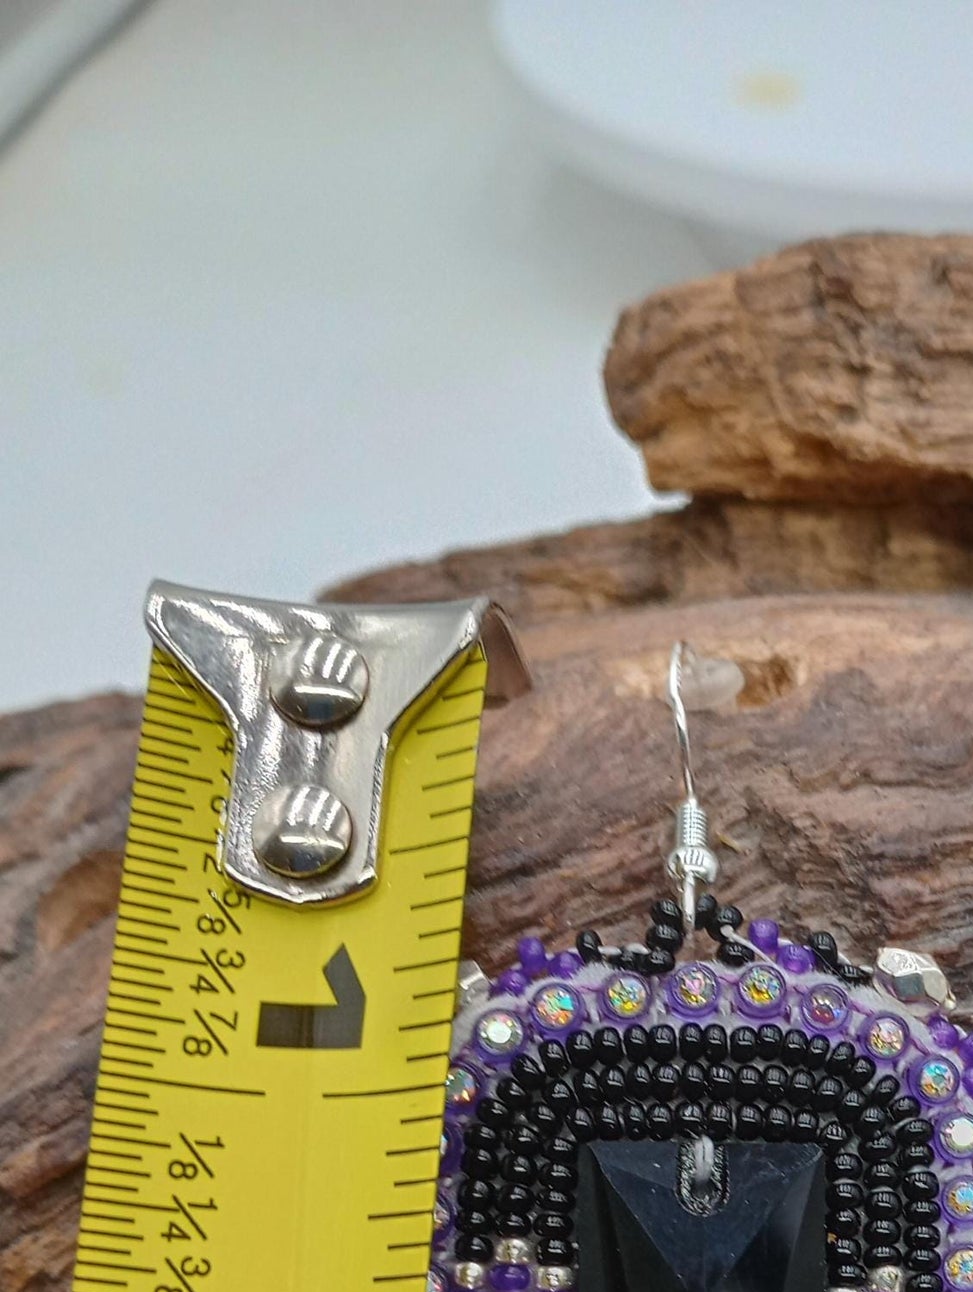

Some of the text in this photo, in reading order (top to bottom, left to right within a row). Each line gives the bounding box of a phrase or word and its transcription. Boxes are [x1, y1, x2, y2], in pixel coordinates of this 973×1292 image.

[190, 948, 246, 994] 3/4
[256, 942, 367, 1050] 1
[182, 1009, 239, 1058] 7/8
[168, 1131, 225, 1181] 1/8
[160, 1194, 218, 1242] 1/4
